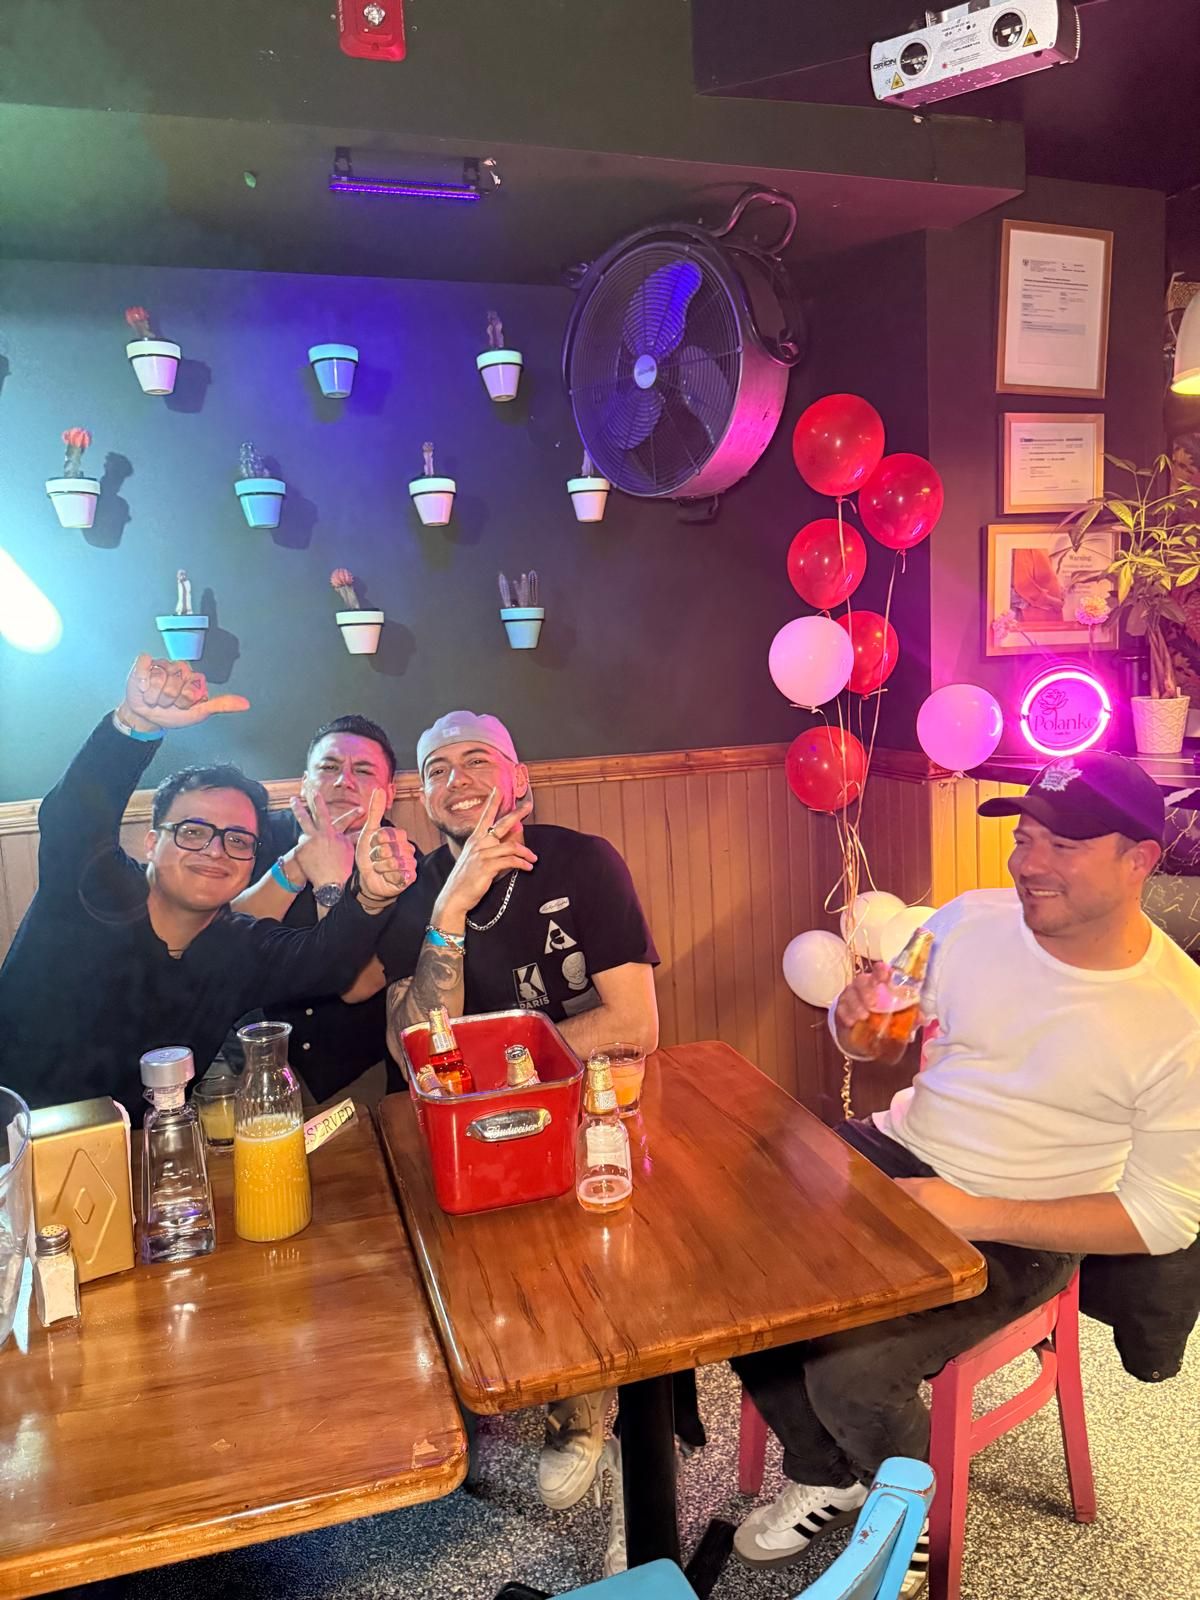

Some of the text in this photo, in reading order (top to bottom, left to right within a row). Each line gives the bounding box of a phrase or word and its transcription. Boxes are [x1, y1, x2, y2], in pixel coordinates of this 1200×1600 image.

[873, 58, 897, 70] ORION
[1035, 713, 1098, 731] Polanko
[519, 996, 550, 1010] PARIS
[304, 1106, 354, 1146] SERVED
[484, 1121, 540, 1139] Budweiser
